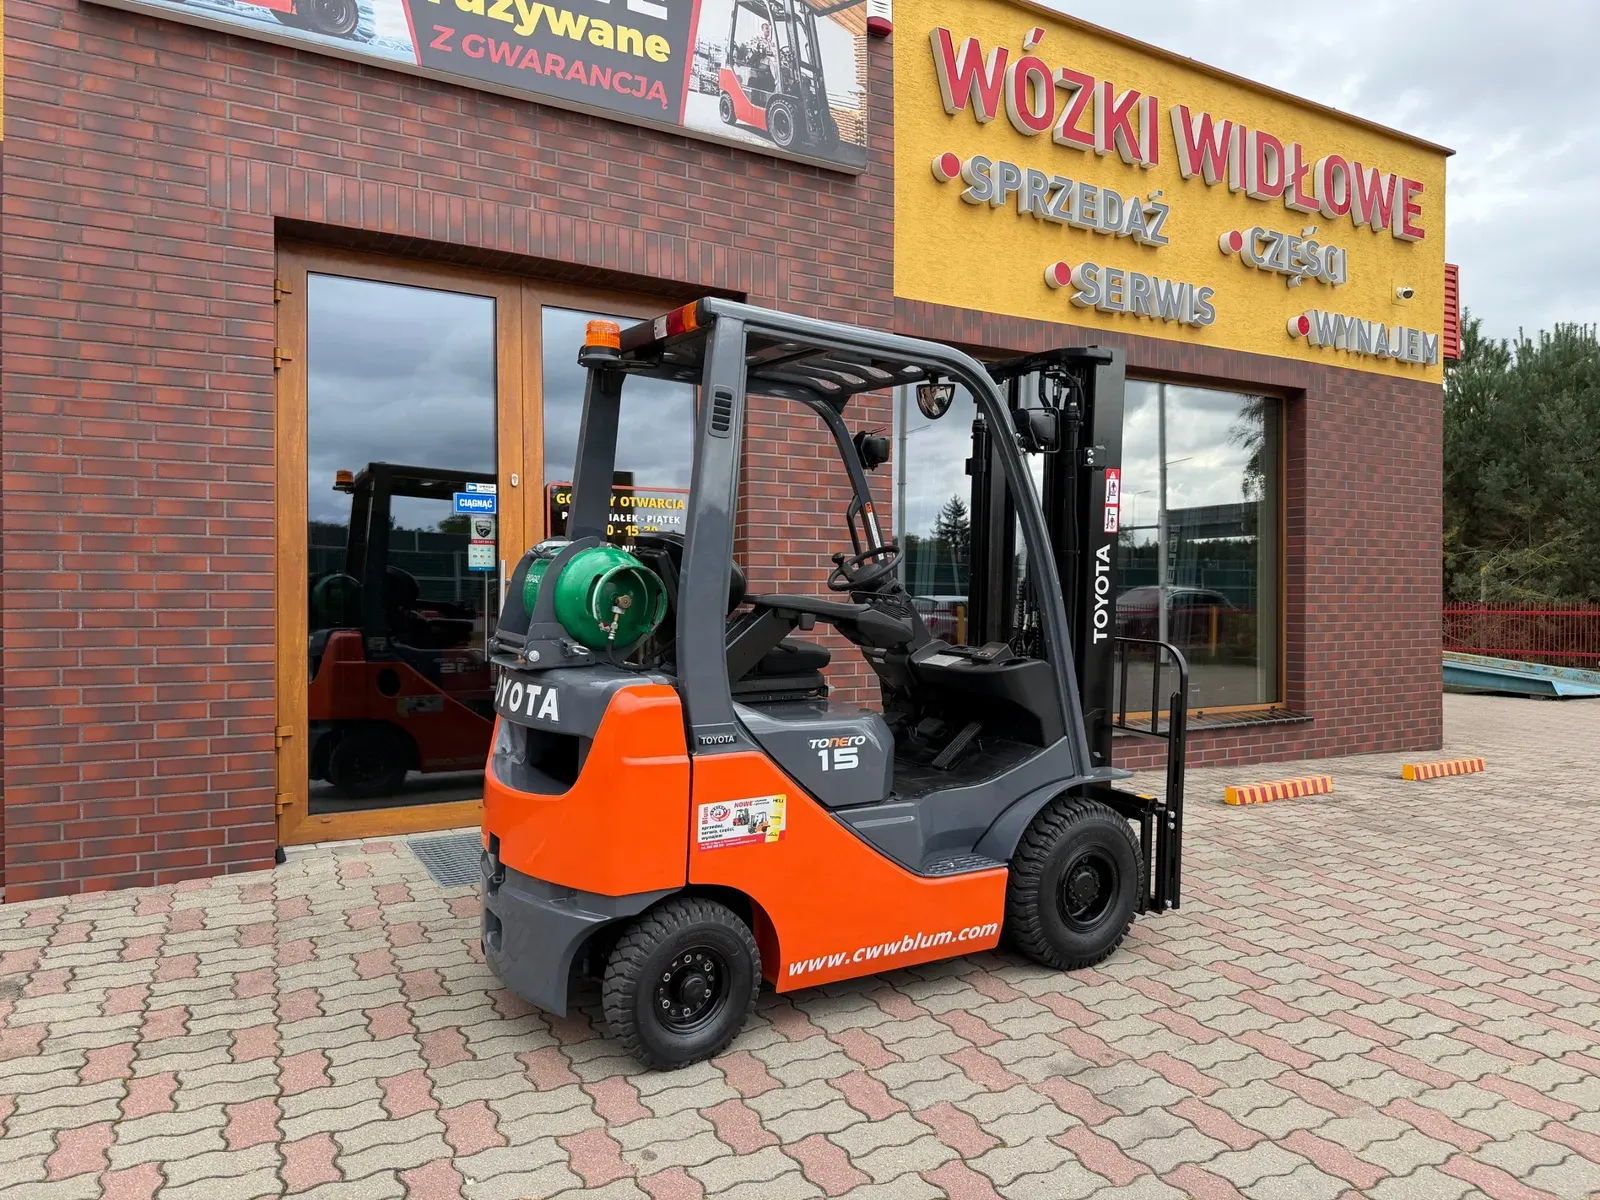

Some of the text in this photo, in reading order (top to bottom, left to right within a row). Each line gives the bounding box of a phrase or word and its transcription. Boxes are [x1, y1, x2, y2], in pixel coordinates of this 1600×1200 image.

[429, 24, 669, 110] Z GWARANCJĄ
[929, 26, 1425, 242] WÓZKI WIDŁOWE
[960, 155, 1170, 248] SPRZEDAŻ
[1240, 225, 1347, 288] CZĘŚCI
[1070, 261, 1216, 328] SERWIS
[1306, 309, 1438, 365] WYNAJEM
[459, 498, 493, 510] CIĄGNĄĆ
[620, 496, 686, 510] OTWARCIA
[646, 514, 681, 526] PIĄTEK
[1093, 543, 1111, 644] TOYOTA
[495, 675, 560, 721] OYOTA
[700, 735, 736, 745] TOYOTA
[818, 748, 860, 771] 15
[788, 920, 999, 977] www.cwwblum.com
